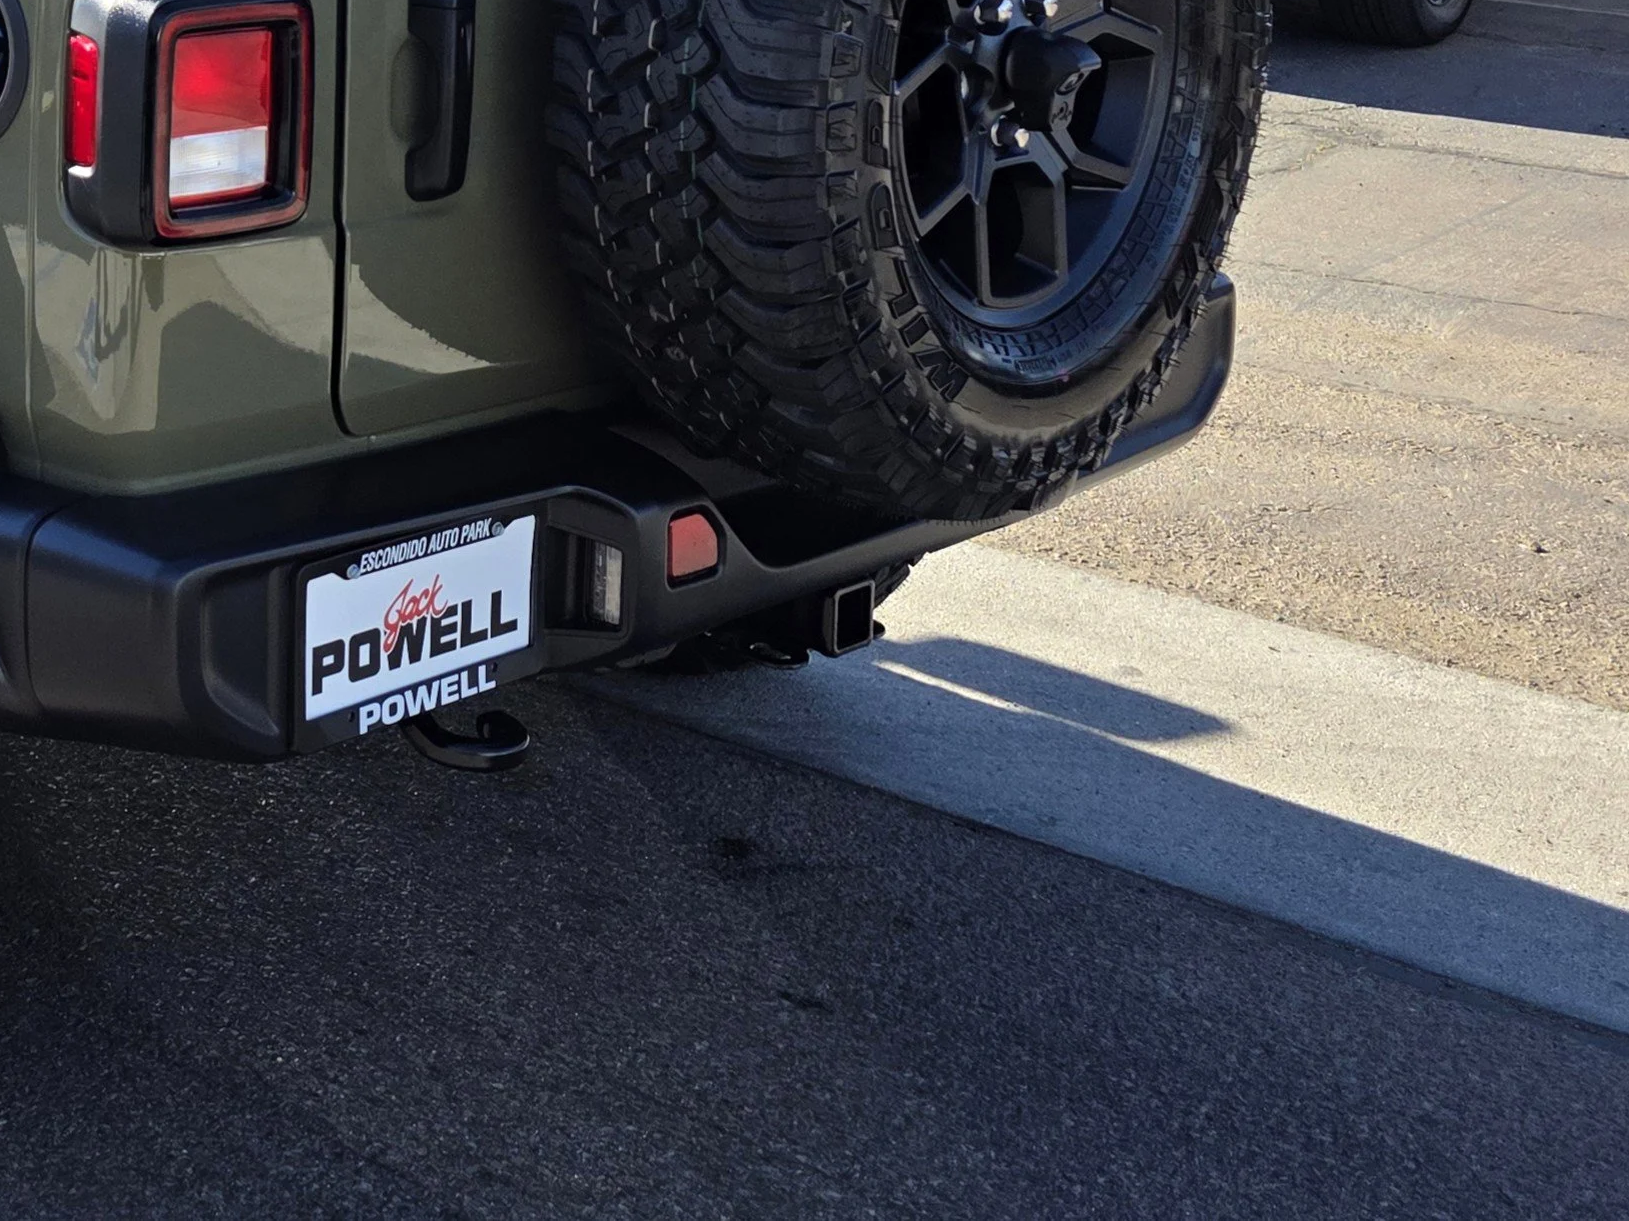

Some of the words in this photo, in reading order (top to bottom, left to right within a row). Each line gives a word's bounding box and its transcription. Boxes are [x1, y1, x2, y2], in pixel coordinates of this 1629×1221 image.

[360, 537, 427, 574] ESCONDIDO
[428, 526, 459, 552] AUTO
[459, 518, 492, 544] PARK
[312, 590, 518, 697] POWELL
[383, 574, 448, 653] Jack
[359, 665, 497, 735] POWELL
